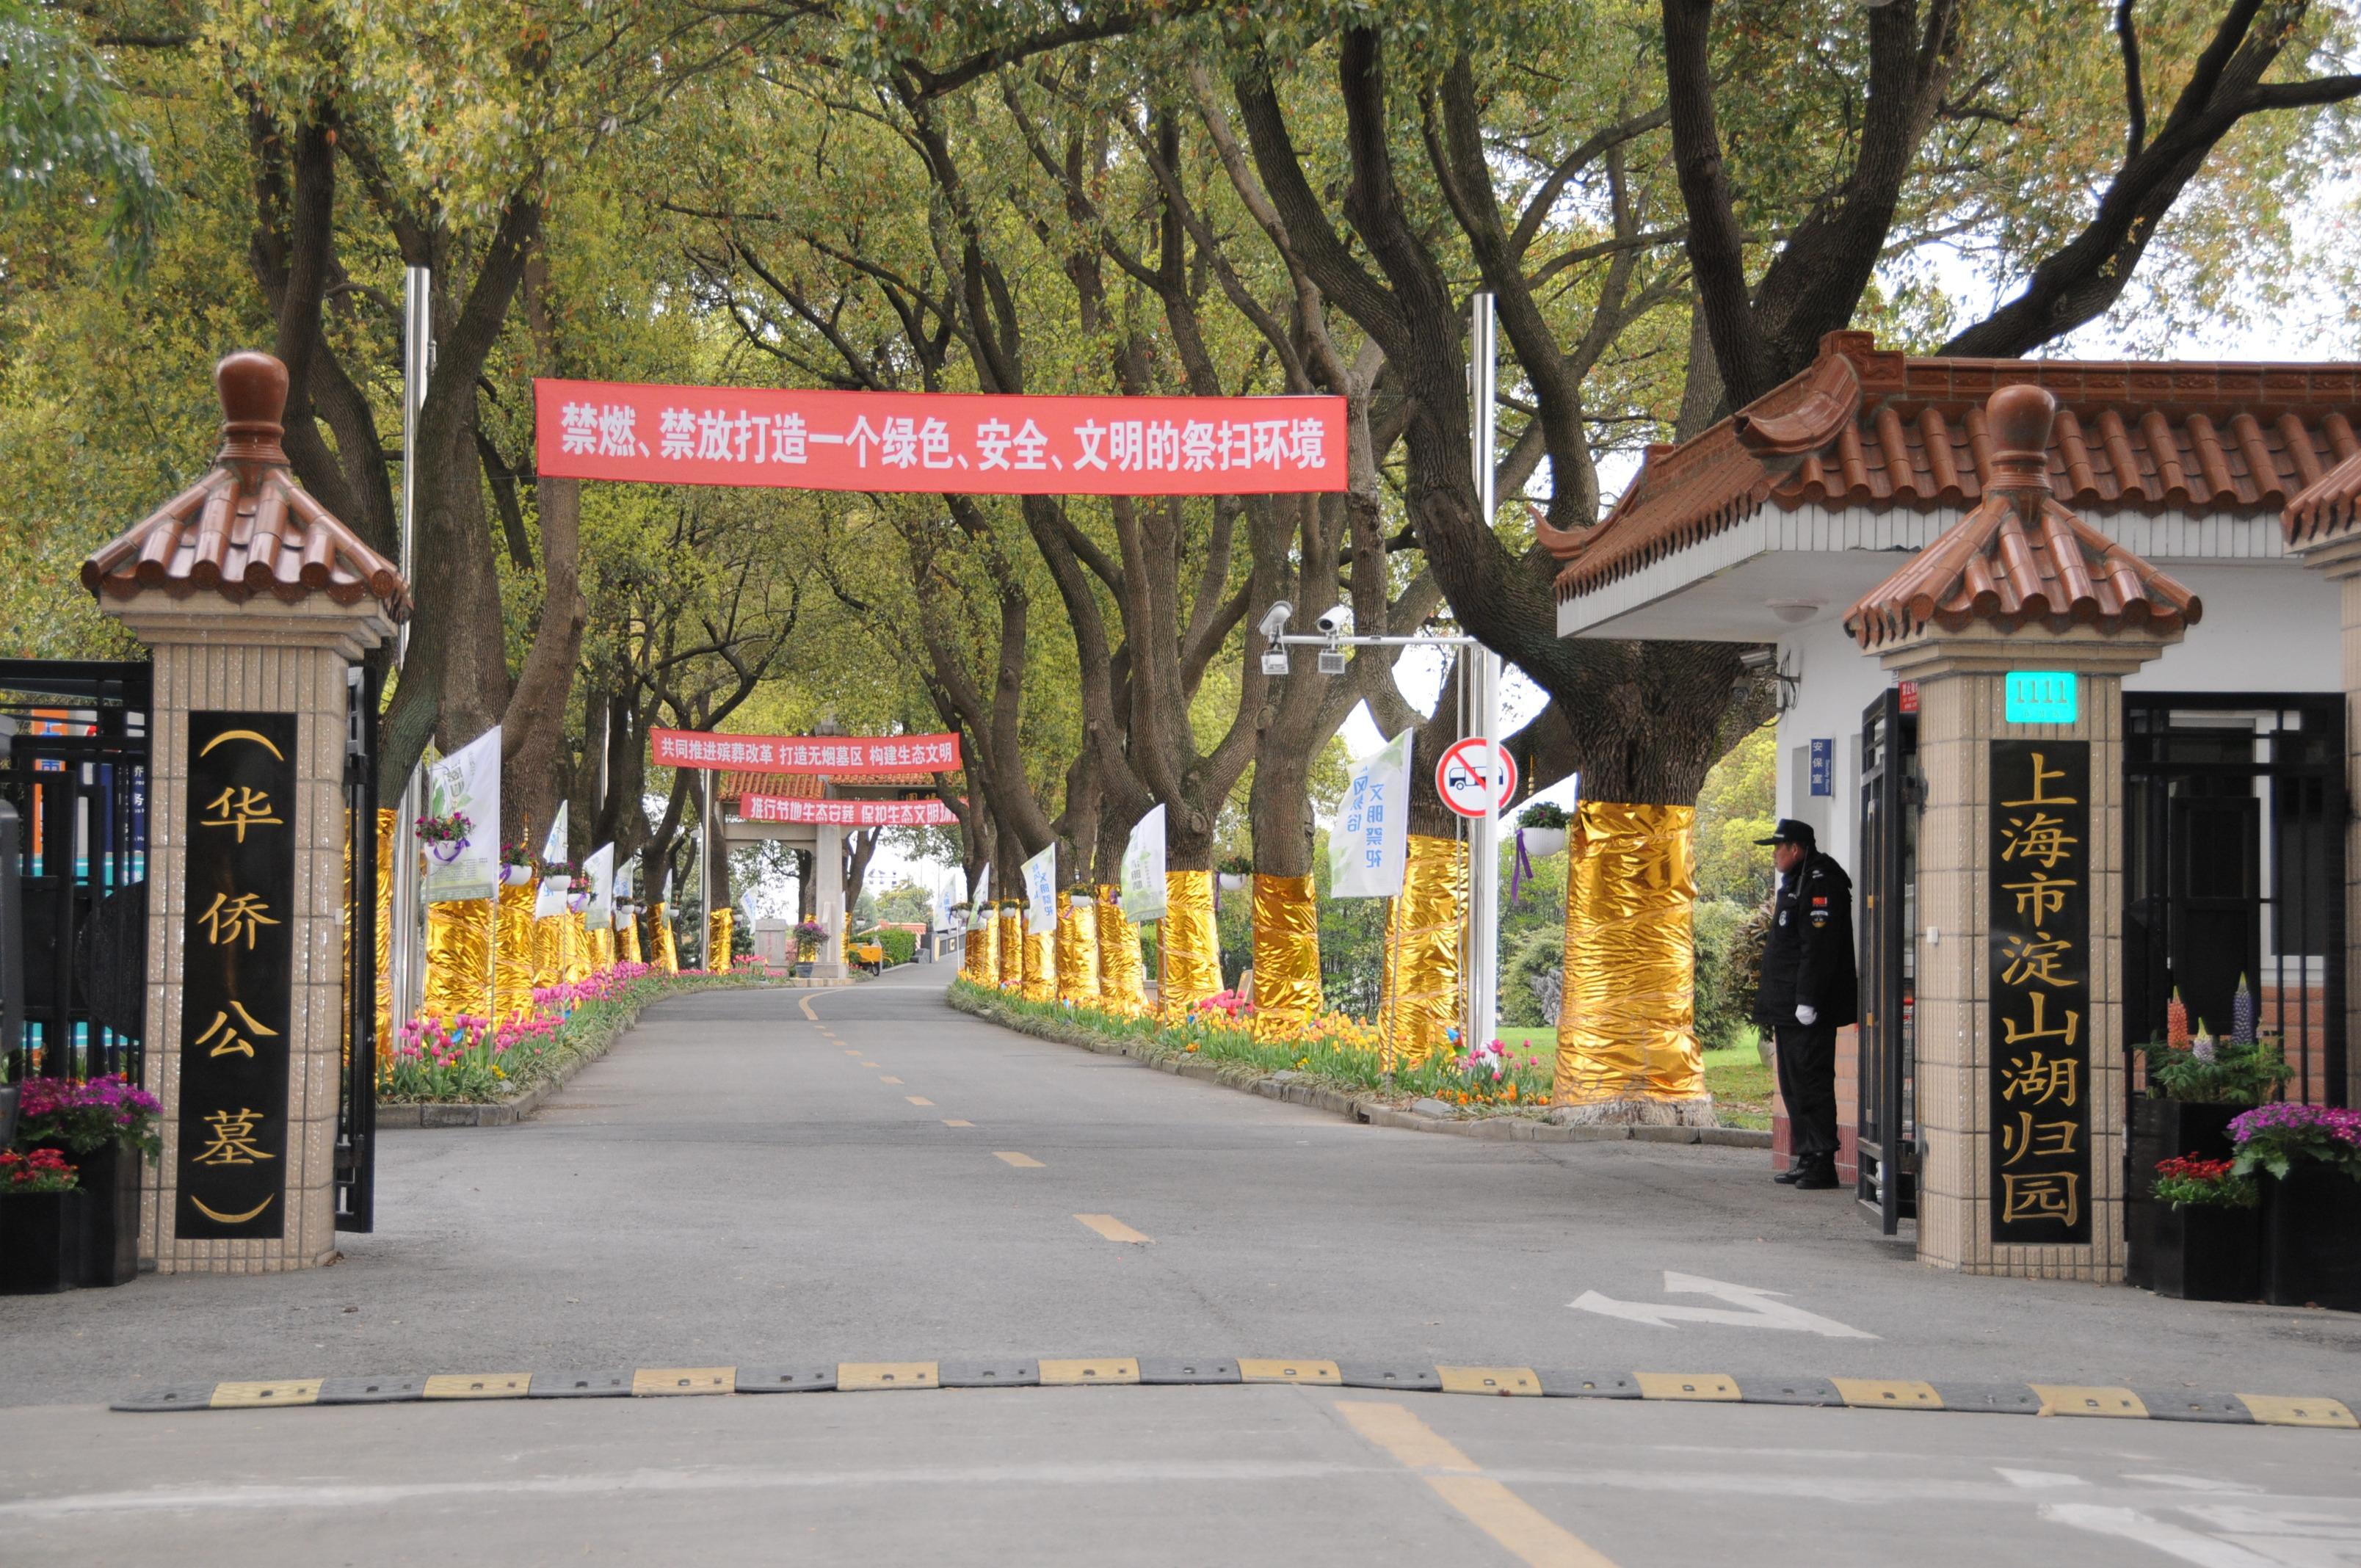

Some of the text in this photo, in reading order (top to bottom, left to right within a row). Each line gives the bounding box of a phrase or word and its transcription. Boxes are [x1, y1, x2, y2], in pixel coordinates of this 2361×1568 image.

[560, 402, 1326, 473] 禁燃、禁放打造一个绿色、安全、文明的祭扫环境
[2015, 680, 2067, 703] 1111
[661, 736, 952, 767] 共同推进殡葬改革 打造无烟墓区 构建生态文明
[1812, 741, 1823, 784] 安保室
[751, 796, 960, 824] 推行节地生态安葬 保护生态文明环
[2001, 752, 2079, 1228] 上海市淀山湖归园
